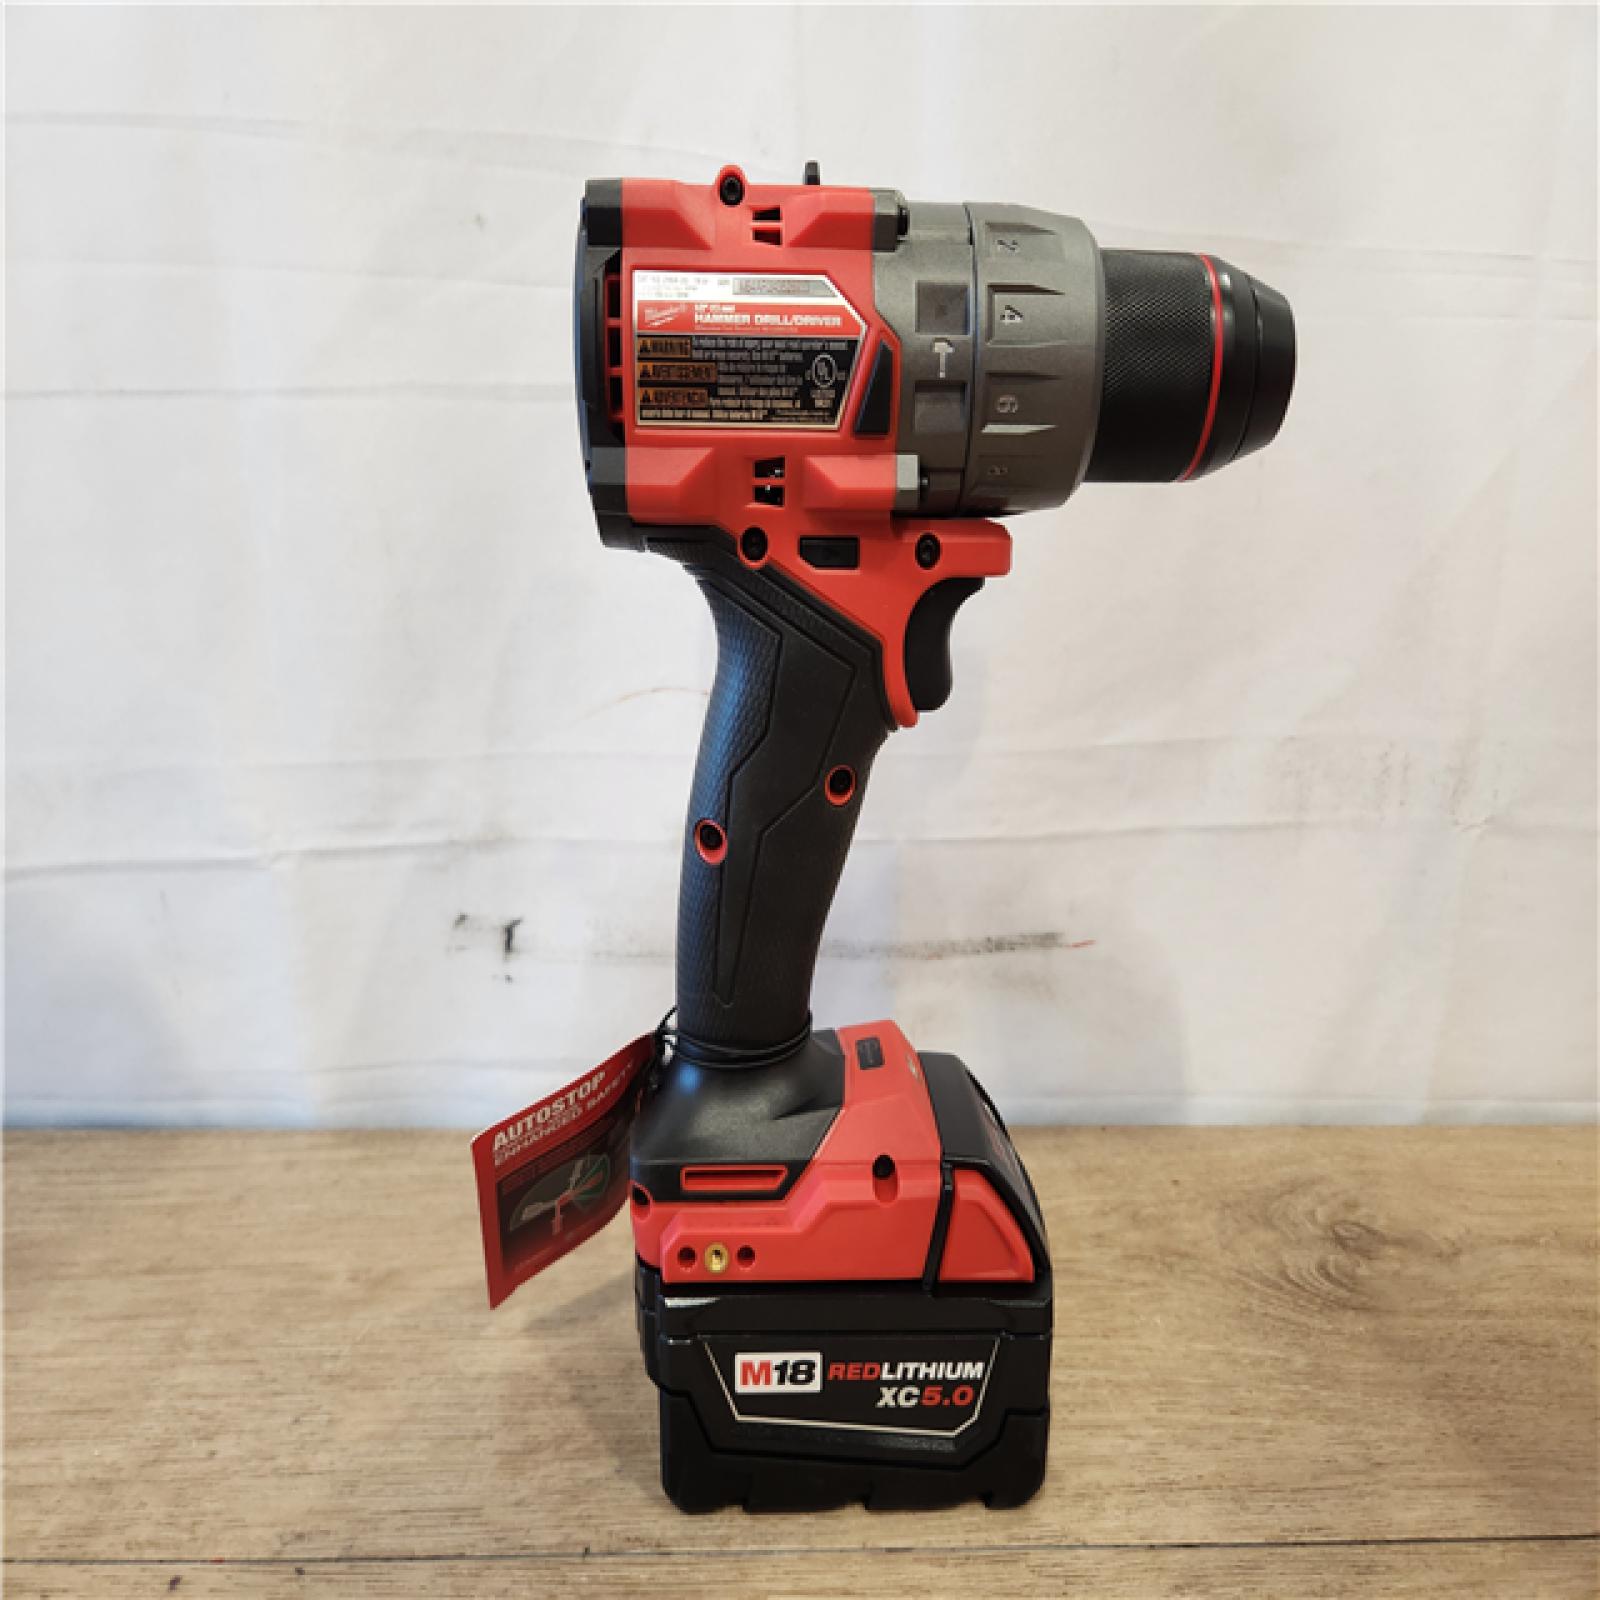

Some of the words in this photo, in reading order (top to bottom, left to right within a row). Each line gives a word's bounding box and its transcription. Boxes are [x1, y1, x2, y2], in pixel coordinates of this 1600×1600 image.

[1000, 304, 1024, 325] 4
[494, 1070, 606, 1151] AUTOSTOP
[740, 1359, 817, 1386] M18
[827, 1361, 986, 1381] REDLITHIUM
[875, 1385, 975, 1409] XC5.0
